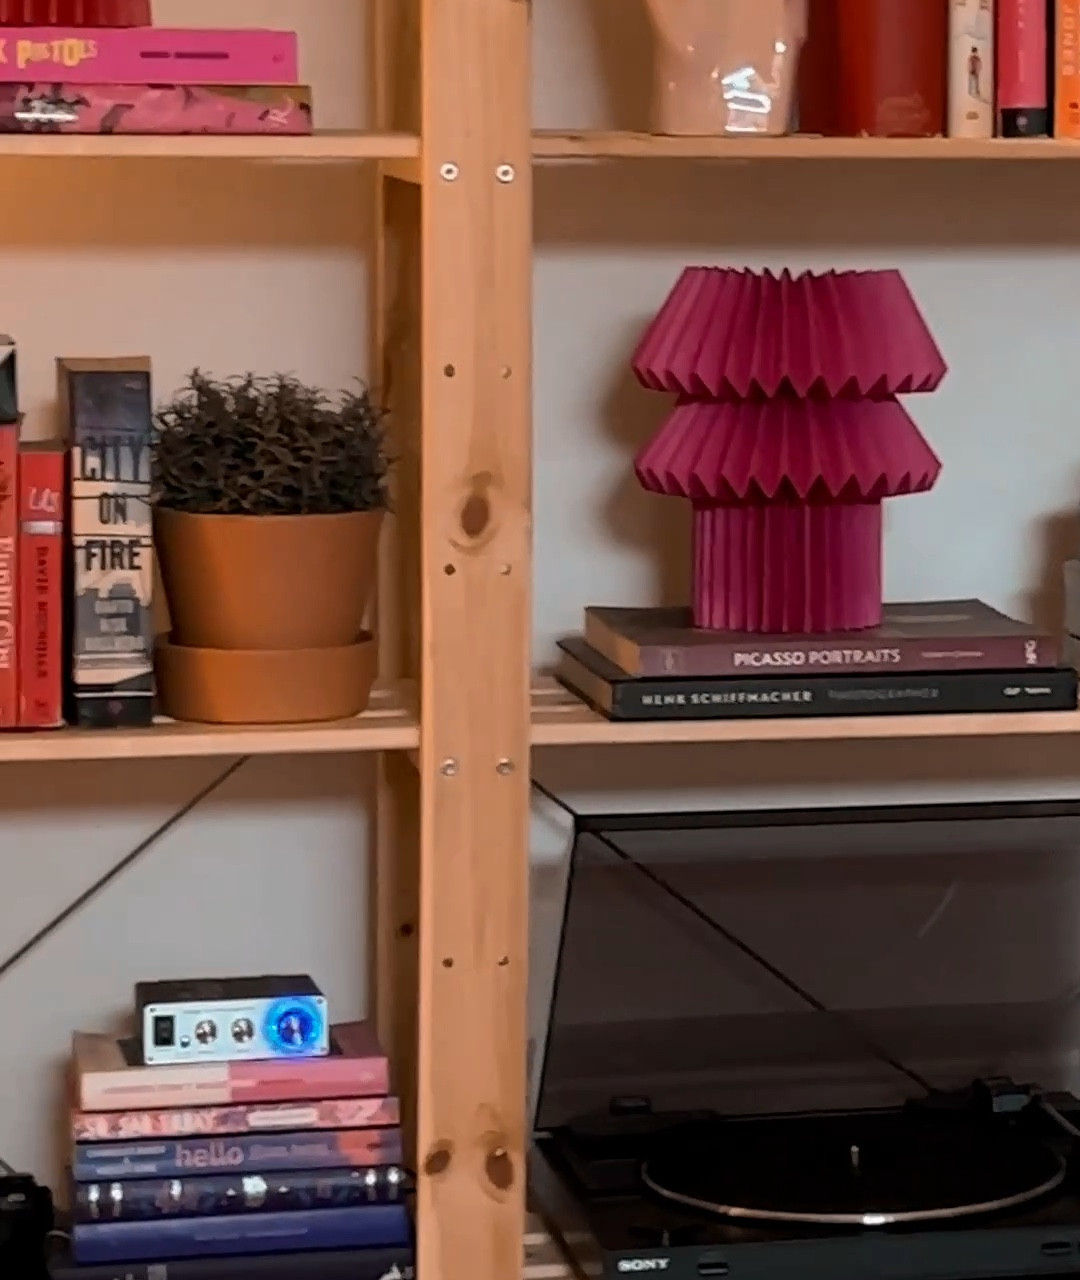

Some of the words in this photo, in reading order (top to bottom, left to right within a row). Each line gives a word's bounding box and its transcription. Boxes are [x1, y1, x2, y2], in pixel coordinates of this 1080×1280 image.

[1062, 3, 1075, 77] JONES
[98, 493, 128, 525] ON
[84, 540, 142, 573] FIRE
[733, 649, 805, 668] PICASSO
[808, 648, 901, 666] PORTRAITS
[175, 1142, 245, 1168] hello
[617, 1258, 669, 1272] SONY
